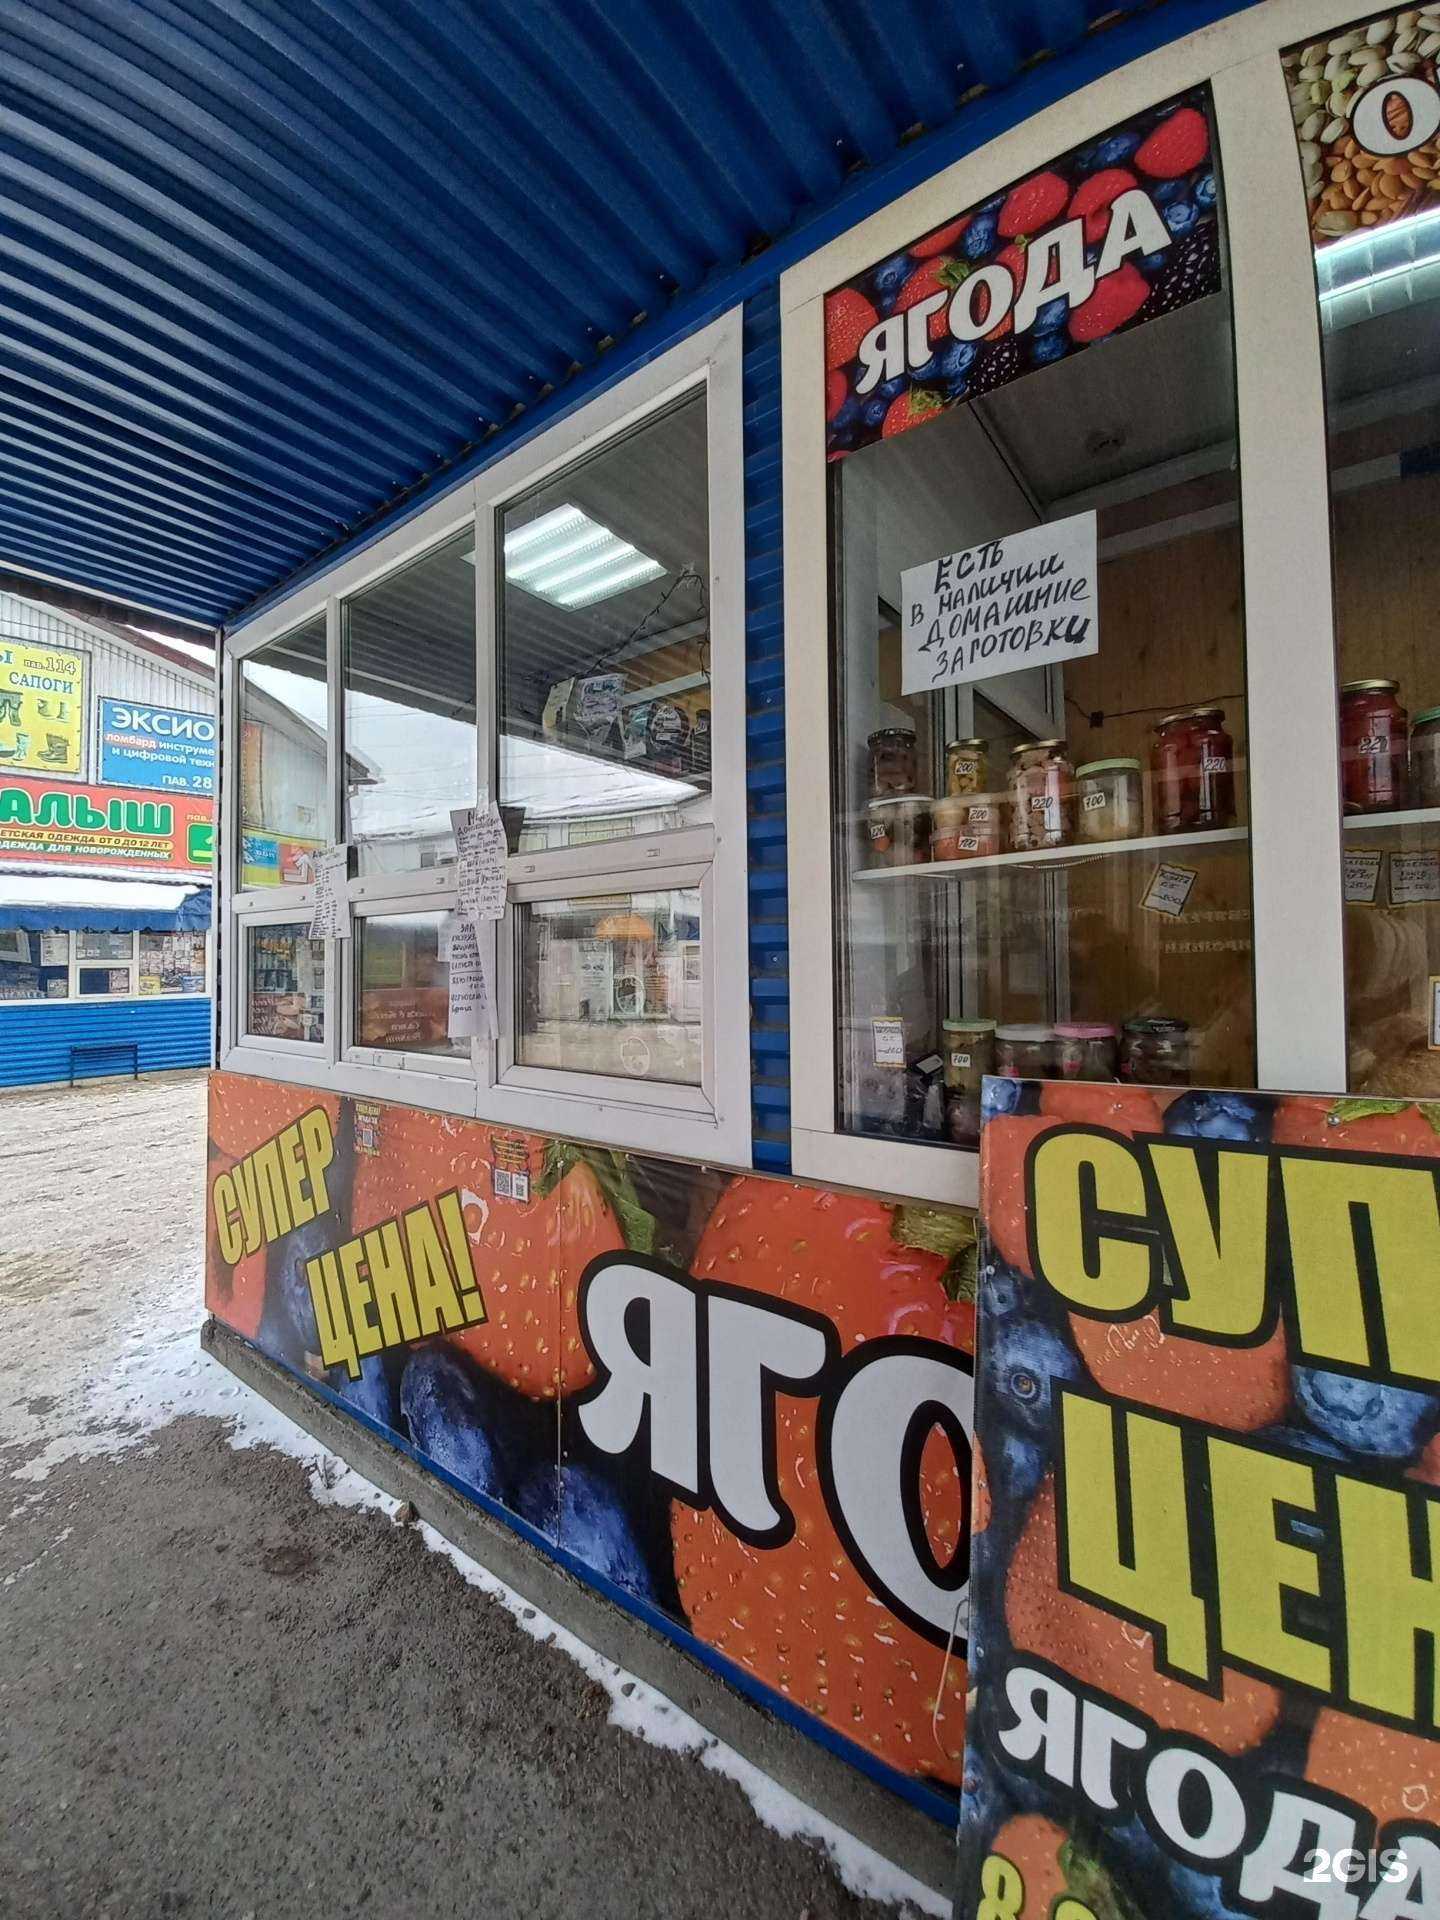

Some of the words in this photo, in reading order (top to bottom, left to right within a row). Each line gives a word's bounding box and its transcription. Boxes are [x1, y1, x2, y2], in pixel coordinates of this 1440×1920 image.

[855, 189, 1172, 394] ЯГОДА
[934, 539, 1004, 594] ЕСТЬ
[932, 615, 1091, 683] ЗАГОТОВКИ
[9, 671, 73, 694] САПОГИ
[105, 733, 157, 749] ломбард
[111, 706, 215, 741] ЭКСИО
[123, 748, 187, 764] цифровой
[0, 787, 174, 836] АЛЫШ
[0, 840, 44, 852] ДЕЖДА
[47, 843, 72, 853] ДЛЯ
[75, 846, 169, 859] НОВОРОЖДЕННЫХ
[47, 831, 96, 844] ОДЕЖДА
[151, 841, 169, 849] ЛЕТ
[214, 1107, 333, 1263] СУПЕР
[1034, 1133, 1440, 1381] СУП
[308, 1189, 487, 1379] ЦЕНА!
[999, 1667, 1440, 1920] ЯГОДА
